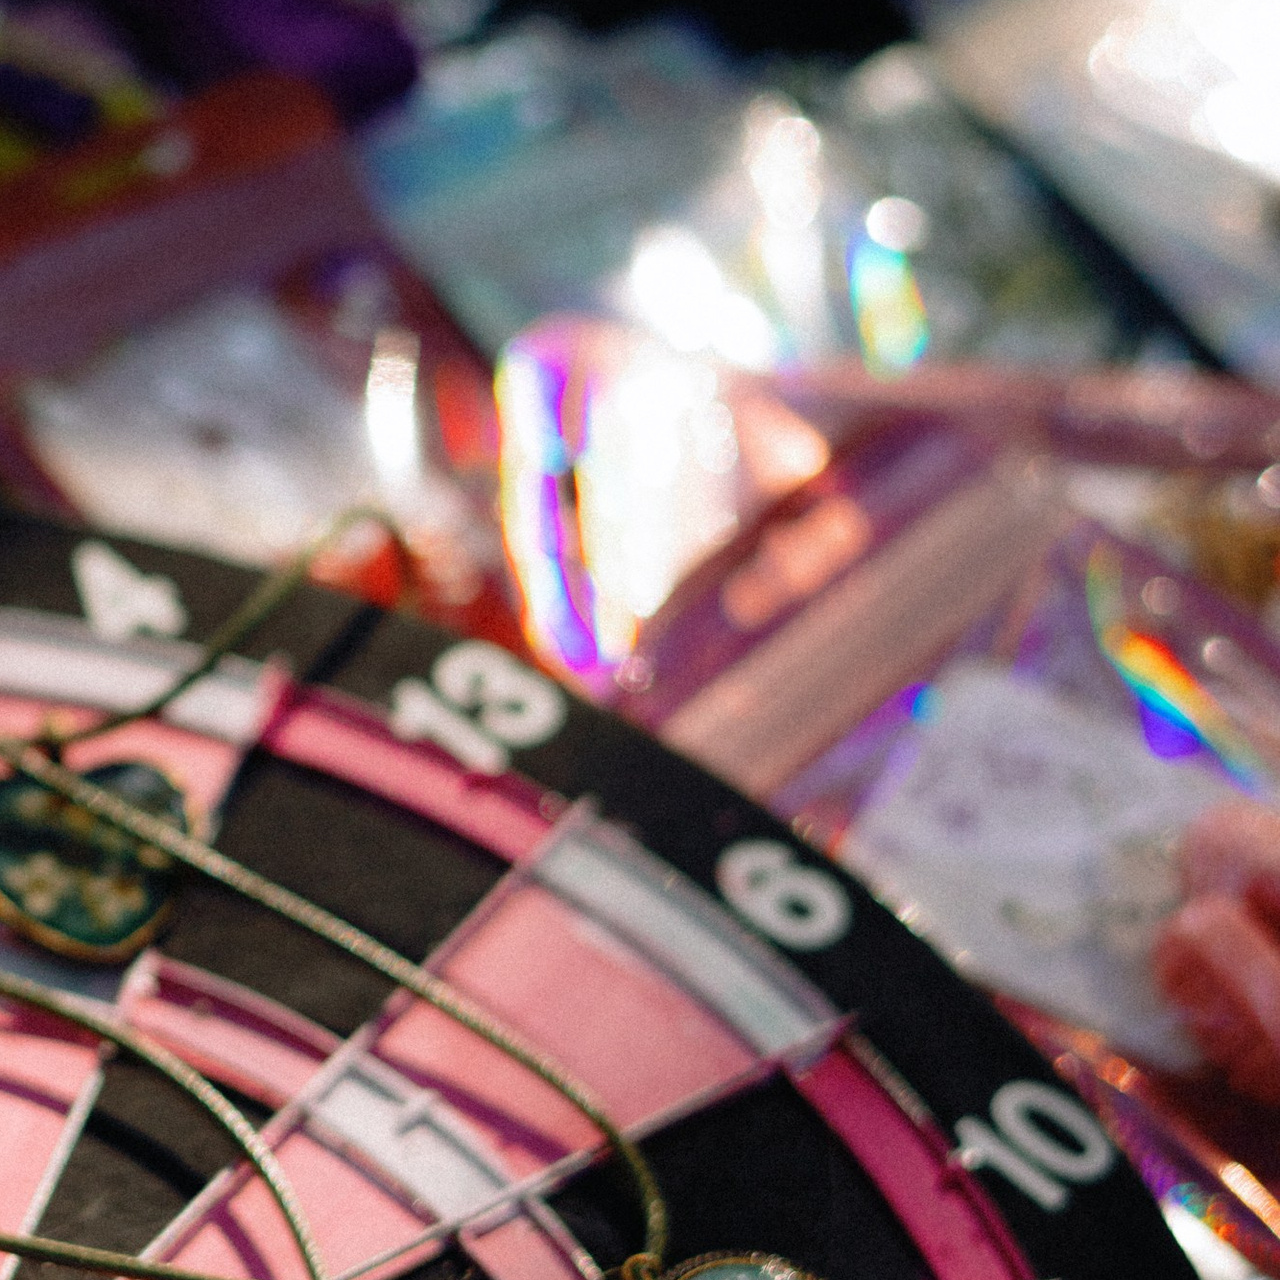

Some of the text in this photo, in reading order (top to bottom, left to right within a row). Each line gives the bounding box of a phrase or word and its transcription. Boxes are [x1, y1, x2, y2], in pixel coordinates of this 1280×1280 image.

[71, 539, 191, 643] 4
[390, 639, 567, 775] 13
[716, 838, 852, 950] 6
[954, 1079, 1113, 1212] 10
